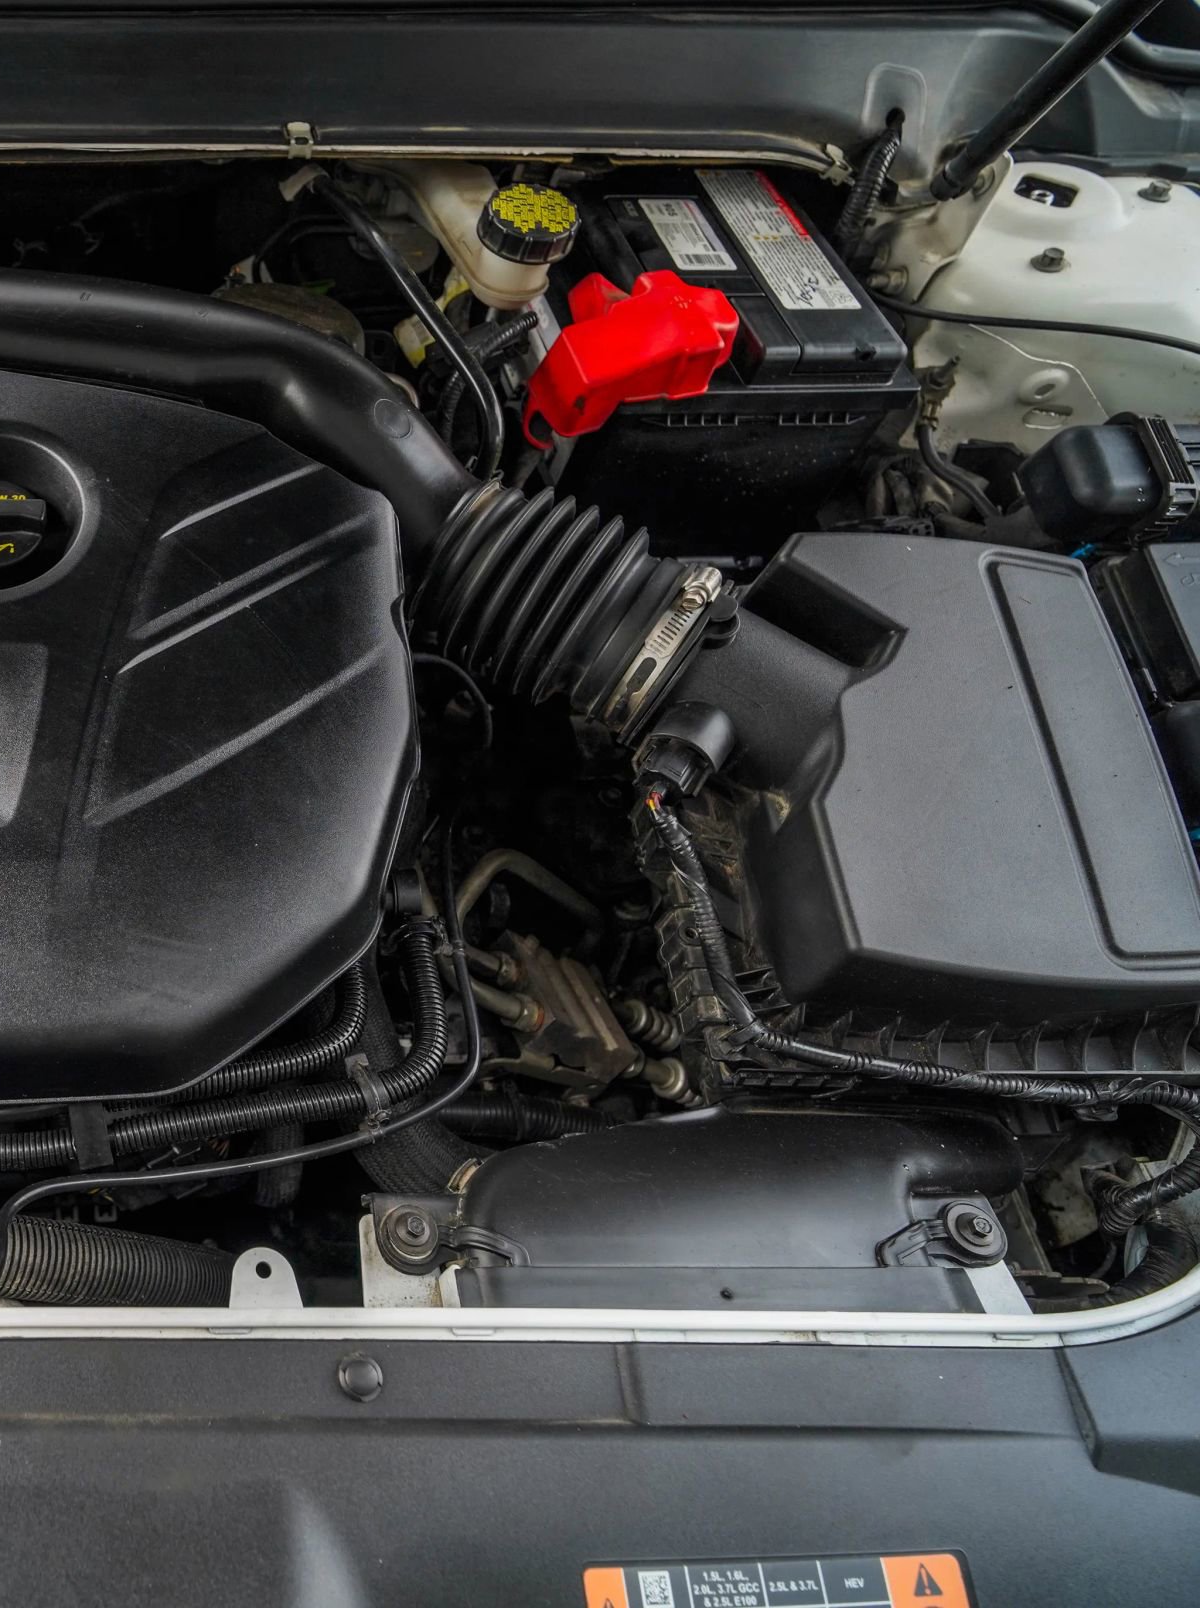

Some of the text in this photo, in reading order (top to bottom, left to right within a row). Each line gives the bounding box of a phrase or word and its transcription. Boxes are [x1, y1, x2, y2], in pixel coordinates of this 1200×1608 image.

[702, 1571, 725, 1581] 1.5L,
[693, 1582, 760, 1595] 2.0L, 3.7L GCC
[769, 1579, 819, 1592] 2.5L & 3.7L
[844, 1578, 865, 1589] HEV
[704, 1595, 757, 1607] & 2.5L E100
